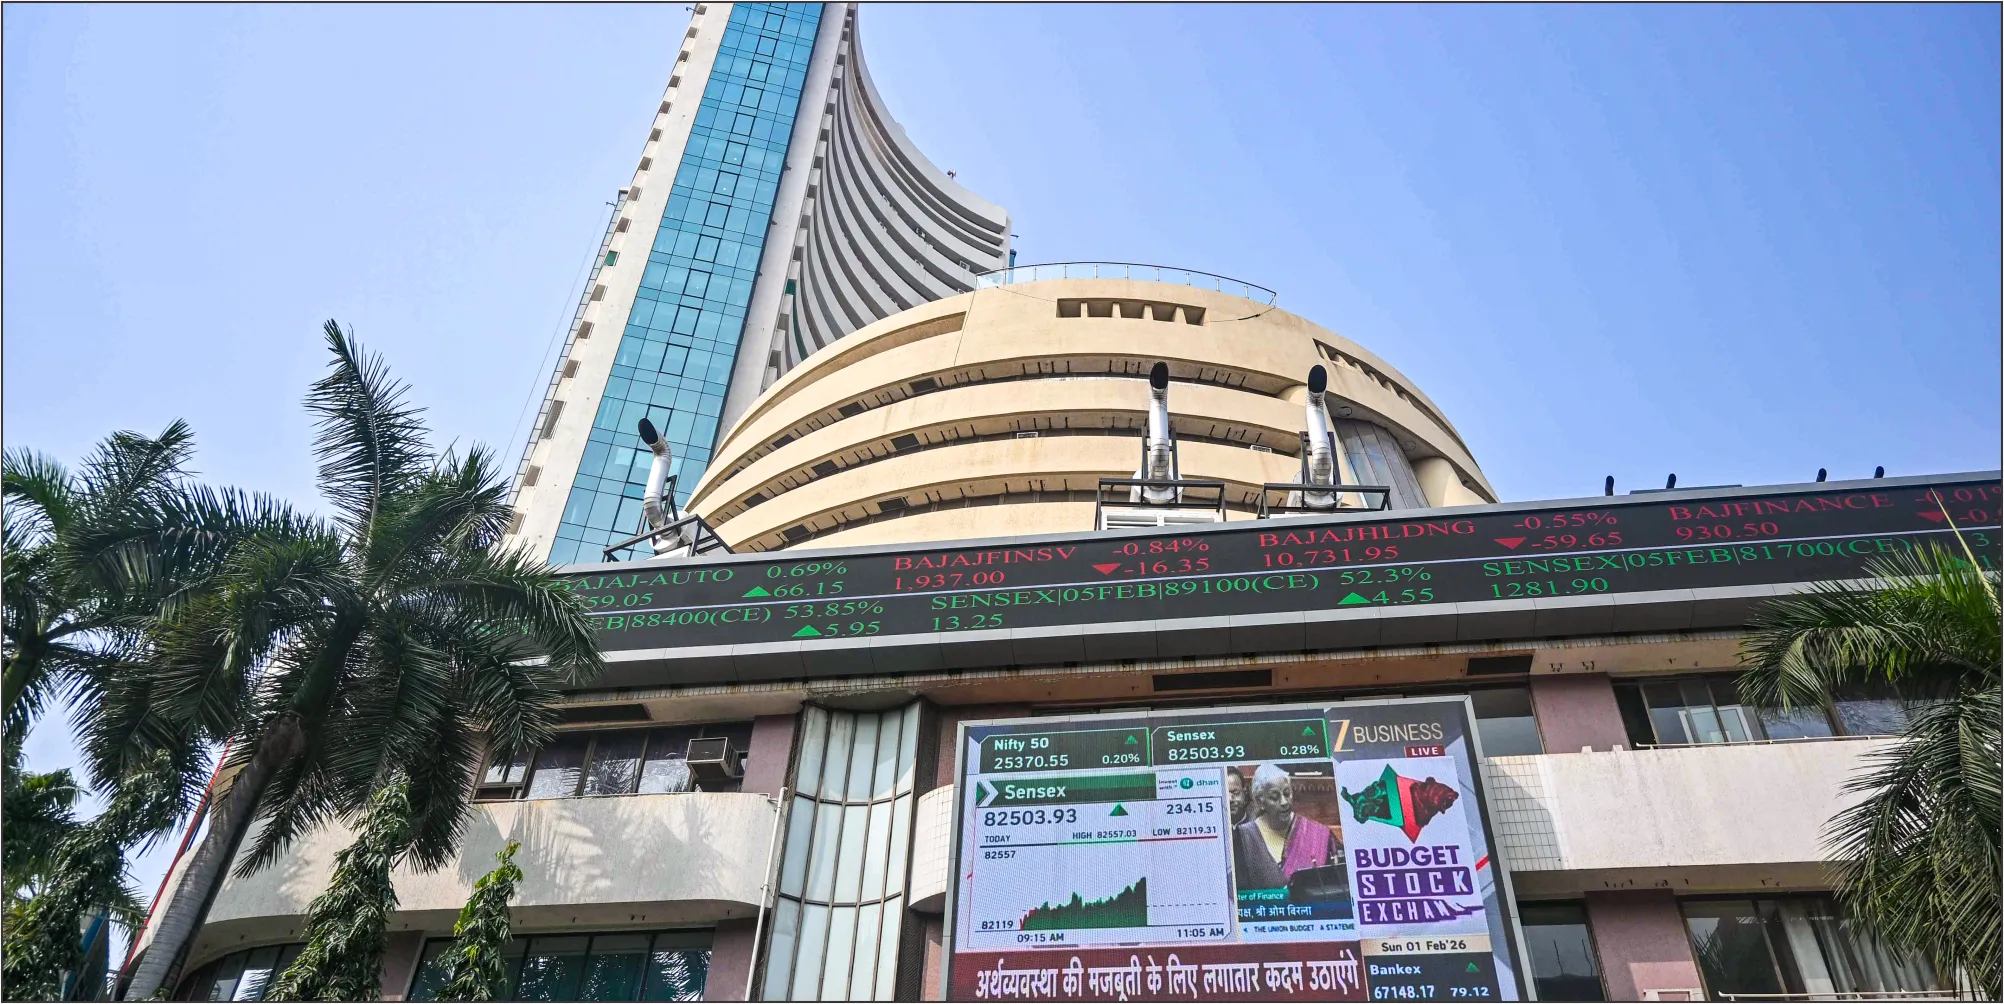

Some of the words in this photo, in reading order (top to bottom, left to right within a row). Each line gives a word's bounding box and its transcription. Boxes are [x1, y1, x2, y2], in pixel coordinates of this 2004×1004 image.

[766, 561, 848, 579] 0.69%
[894, 545, 1076, 571] BAJAJFINSV
[1113, 538, 1210, 556] -0.84%
[1259, 520, 1476, 548] BAJAJHLDNG
[1513, 511, 1619, 530] -0.55%
[1668, 493, 1895, 521] BAJFINANCE
[773, 580, 844, 598] 66.15
[894, 570, 1006, 591] 1,937.00
[1124, 557, 1210, 576] -16.35
[1263, 545, 1399, 567] 10,731.95
[1531, 531, 1623, 549] -59.65
[1676, 521, 1780, 541] 930.50
[784, 600, 885, 619] 53.85%
[931, 573, 1320, 610] SENSEX|05FEB|89100(CE)
[1340, 567, 1432, 585] 52.3%
[824, 620, 881, 637] 5.95
[932, 613, 1004, 631] 13.25
[1371, 587, 1435, 605] 4.55
[1491, 577, 1609, 598] 1281.90
[1167, 730, 1216, 742] Sensex
[1353, 722, 1444, 744] BUSINESS
[994, 739, 1025, 752] Nifty
[1030, 737, 1049, 749] 50
[1168, 746, 1245, 761] 82503.93
[1280, 744, 1320, 756] 0.28%
[1411, 746, 1439, 756] LIVE
[994, 754, 1069, 770] 25370.55
[1102, 753, 1140, 765] 0.20%
[1196, 779, 1219, 787] dhan
[1004, 784, 1067, 800] Sensex
[984, 808, 1077, 827] 82503.93
[1166, 802, 1214, 815] 234.15
[985, 834, 1011, 844] TODAY
[1072, 831, 1093, 840] HIGH
[1097, 829, 1137, 839] 82557.03
[1152, 827, 1171, 837] LOW
[1176, 826, 1217, 836] 82119.31
[984, 850, 1016, 860] 82557
[1355, 844, 1460, 869] BUDGET
[1361, 870, 1469, 896] STOCK
[1249, 892, 1256, 901] of
[1257, 892, 1284, 900] Finance
[981, 920, 1014, 930] 82119
[1254, 925, 1267, 933] THE
[1290, 924, 1315, 932] BUDGET
[1017, 933, 1046, 943] 09:15
[1050, 932, 1064, 942] AM
[1177, 928, 1206, 938] 11:05
[1209, 927, 1225, 937] AM
[1381, 942, 1402, 952] Sun
[1406, 941, 1421, 952] 01
[1426, 939, 1466, 951] Feb'26
[975, 957, 1058, 999] अर्थव्यवस्था
[1062, 955, 1084, 997] की
[1088, 954, 1142, 1001] मजबूती
[1145, 954, 1162, 996] के
[1166, 953, 1198, 999] लिए
[1202, 961, 1260, 993] लगातार
[1263, 961, 1304, 994] कदम
[1306, 948, 1359, 995] उठाएंगे
[1369, 963, 1421, 976] Bankex
[1374, 985, 1435, 999] 67148.17
[1450, 986, 1490, 997] 79.12
